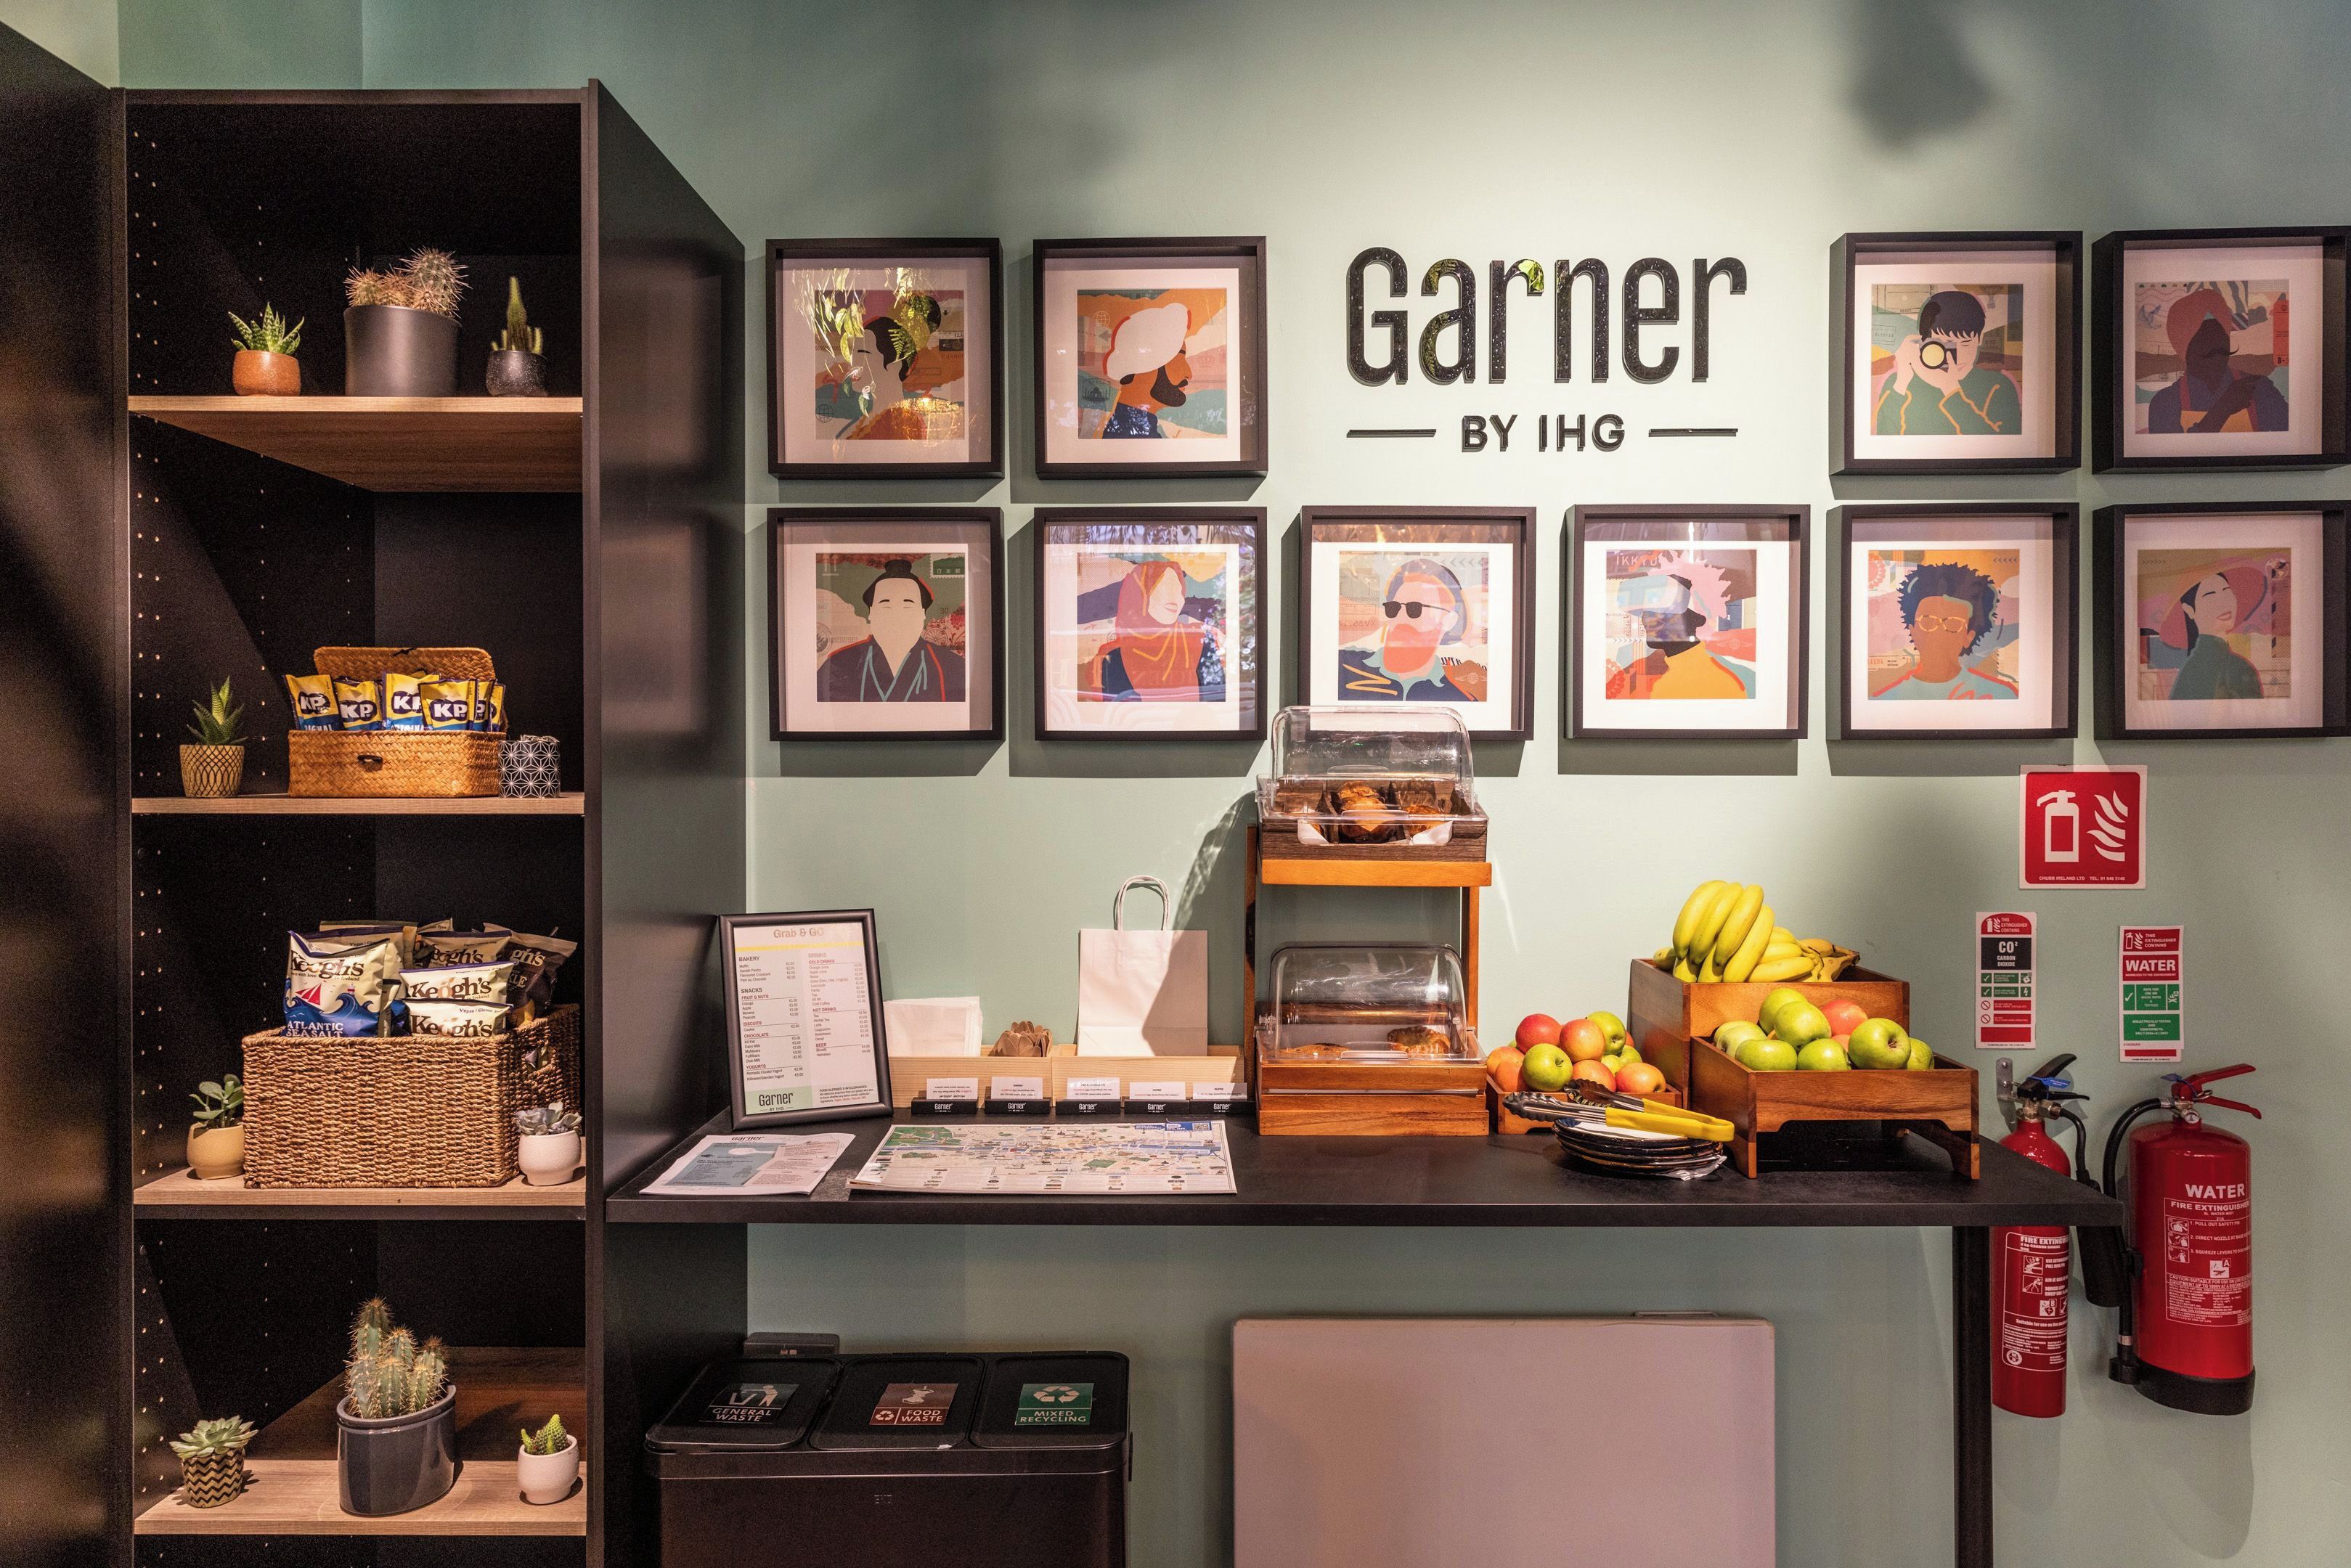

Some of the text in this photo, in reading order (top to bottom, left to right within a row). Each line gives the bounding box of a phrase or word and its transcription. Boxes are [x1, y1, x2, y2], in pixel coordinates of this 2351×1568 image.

[1347, 247, 1747, 385] Garner
[1462, 414, 1624, 452] BY IHG
[301, 696, 326, 710] KP
[433, 703, 468, 717] KP
[341, 703, 373, 718] KP
[773, 928, 796, 938] Grab
[2125, 960, 2176, 971] WATER
[410, 977, 492, 999] Keogh's
[286, 1029, 310, 1037] SEA
[288, 1021, 343, 1031] ATLANTIC
[411, 1015, 493, 1037] Keogh's
[759, 1093, 794, 1106] Garner
[2185, 1183, 2245, 1199] WATER
[2171, 1201, 2193, 1210] FIRE
